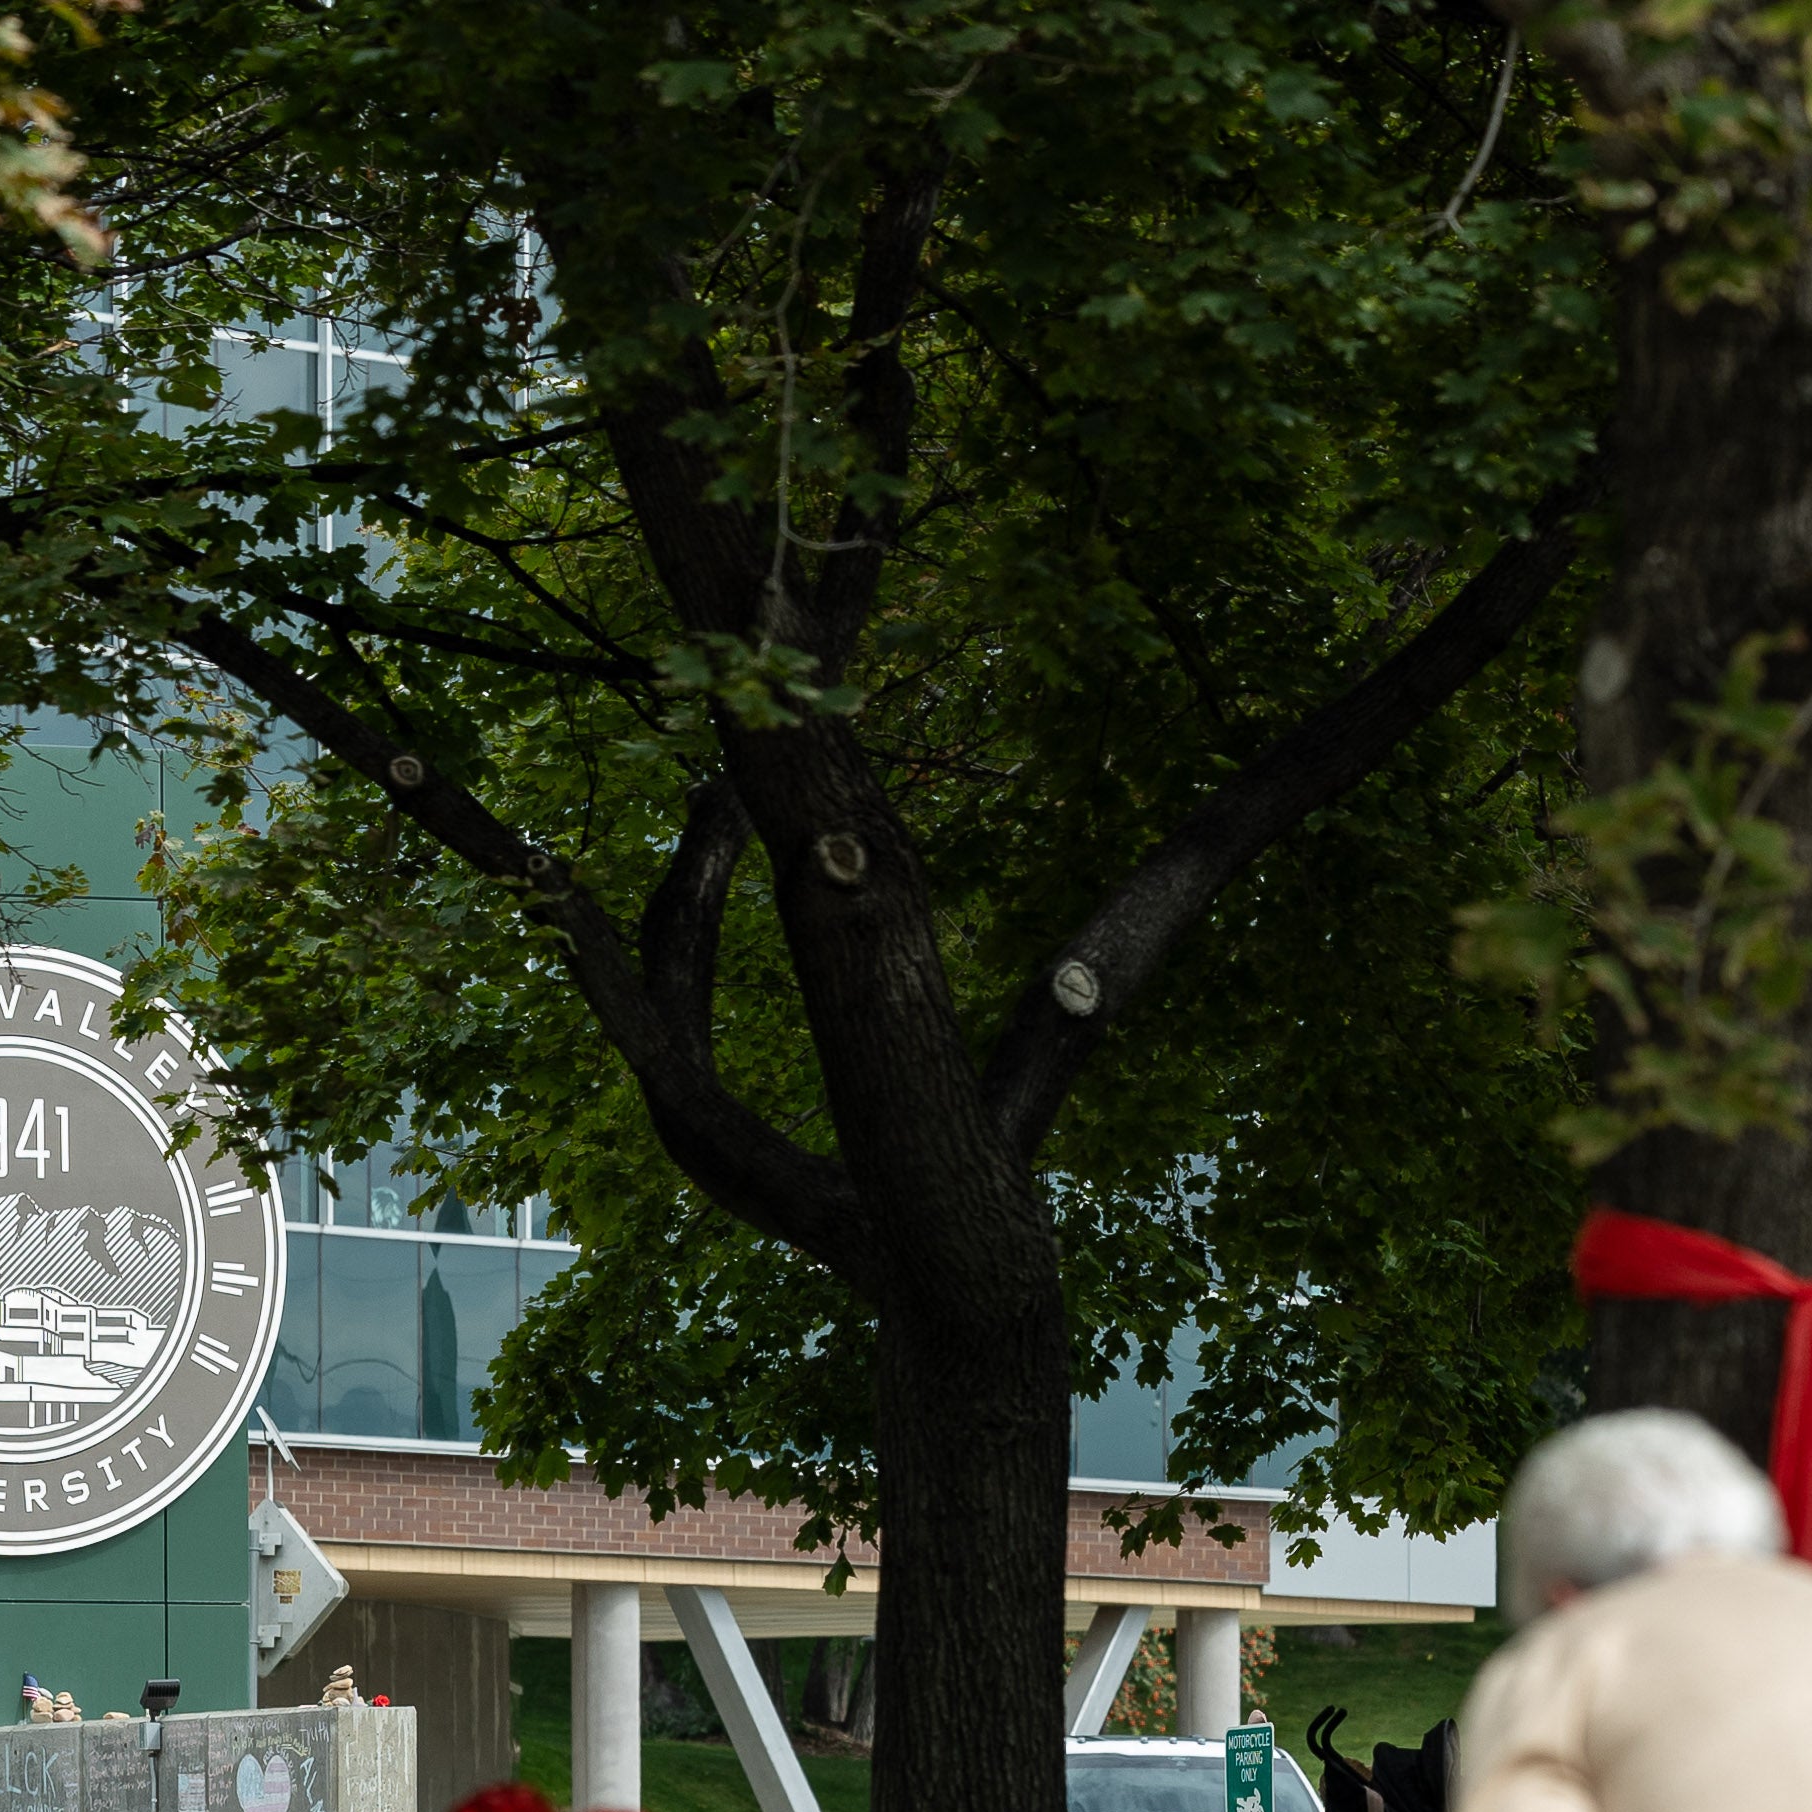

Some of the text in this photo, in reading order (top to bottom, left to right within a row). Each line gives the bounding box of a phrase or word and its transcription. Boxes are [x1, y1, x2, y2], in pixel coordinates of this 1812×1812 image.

[1228, 1732, 1270, 1750] MOTORCYCLE
[1235, 1749, 1262, 1766] PARKING
[1240, 1770, 1258, 1783] ONLY
